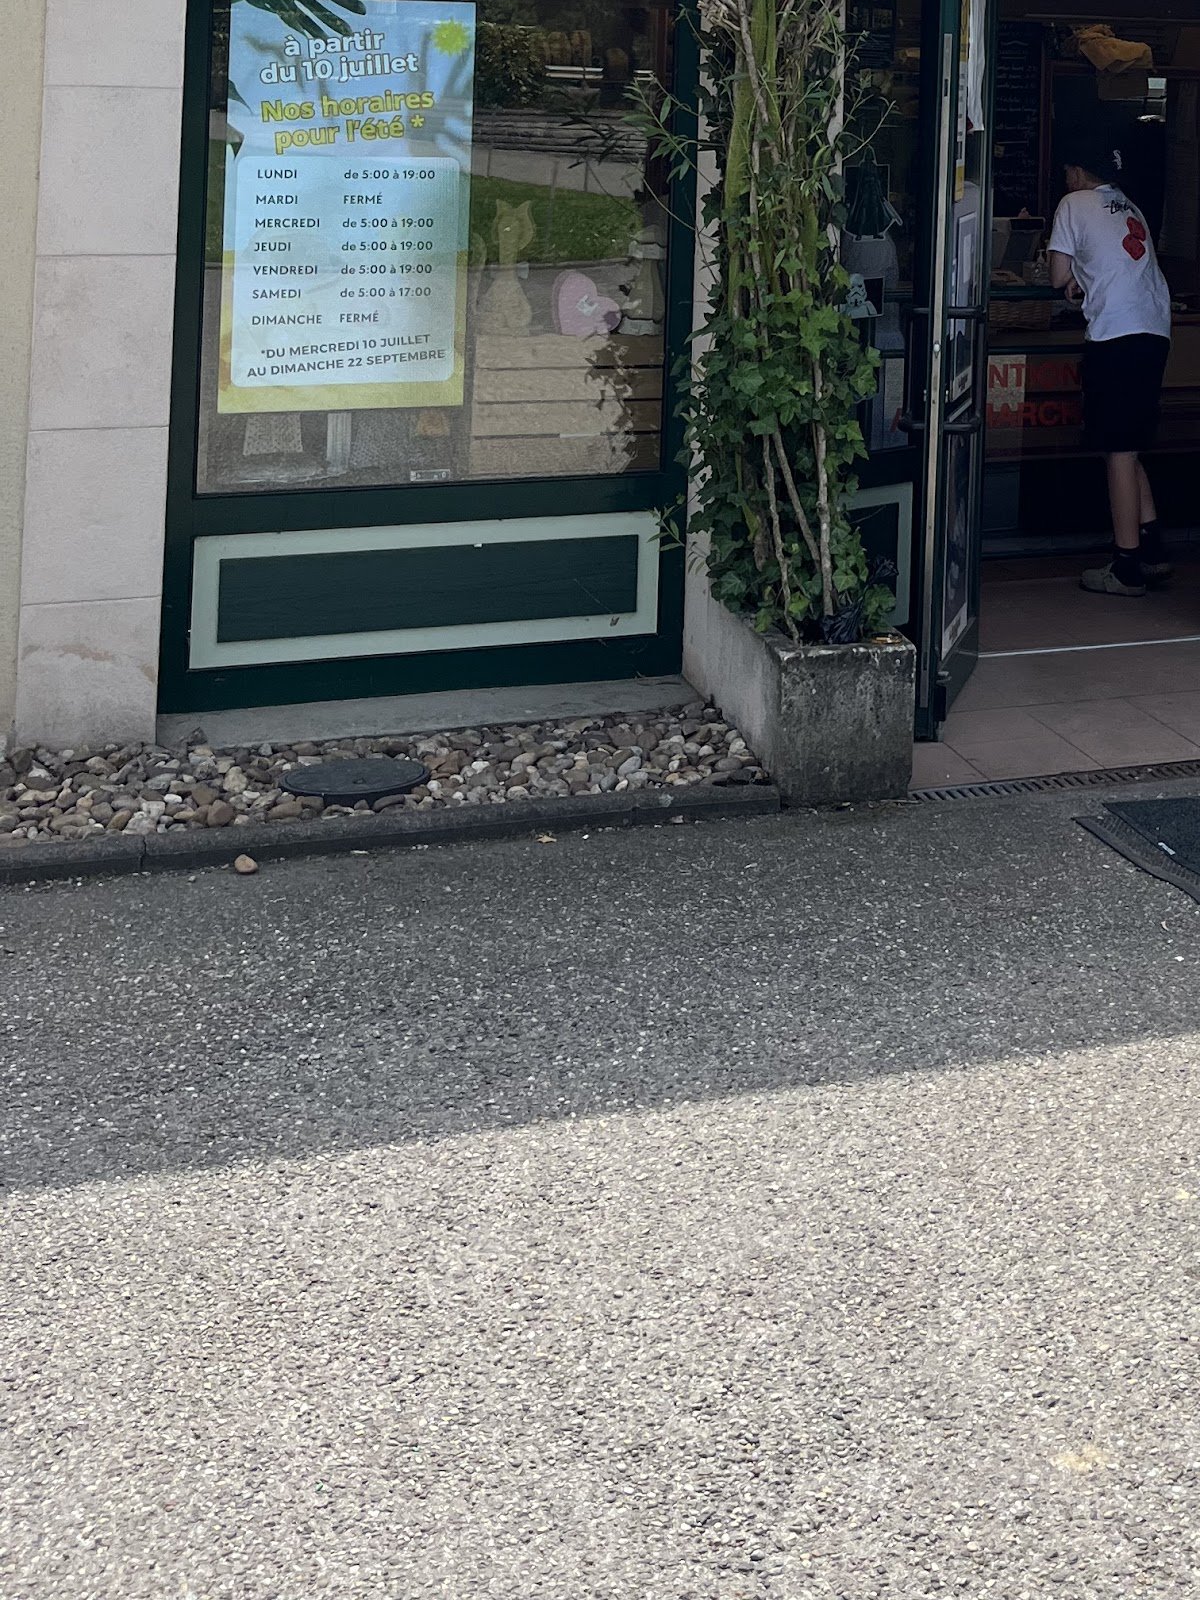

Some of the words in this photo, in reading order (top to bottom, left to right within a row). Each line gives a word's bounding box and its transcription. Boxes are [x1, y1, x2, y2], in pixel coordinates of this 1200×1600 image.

[284, 34, 301, 57] à
[307, 27, 386, 60] partir
[259, 61, 298, 85] du
[301, 58, 334, 81] 10
[338, 52, 420, 83] juillet
[260, 99, 316, 123] Nos
[321, 89, 435, 118] horaires
[274, 124, 340, 155] pour
[345, 114, 405, 143] l'été
[256, 168, 298, 179] LUNDI
[343, 169, 359, 179] de
[361, 169, 390, 179] 5:00
[392, 169, 400, 180] à
[402, 169, 436, 180] 19:00
[255, 194, 299, 205] MARDI
[342, 192, 383, 205] FERMÉ
[254, 217, 321, 229] MERCREDI
[342, 218, 357, 228] de
[360, 218, 388, 228] 5:00
[391, 218, 398, 228] à
[401, 218, 434, 228] 19:00
[253, 241, 292, 252] JEUDI
[341, 241, 356, 251] de
[359, 241, 387, 251] 5:00
[390, 241, 398, 251] à
[400, 240, 433, 251] 19:00
[253, 265, 318, 276] VENDREDI
[340, 264, 355, 275] de
[358, 264, 387, 274] 5:00
[389, 264, 397, 274] à
[399, 264, 433, 274] 19:00
[252, 289, 301, 299] SAMEDI
[339, 288, 355, 298] de
[358, 287, 386, 298] 5:00
[388, 287, 396, 297] à
[398, 287, 432, 297] 17:00
[251, 314, 322, 326] DIMANCHE
[339, 310, 380, 323] FERMÉ
[289, 341, 359, 357] MERCREDI
[362, 339, 377, 349] 10
[379, 333, 431, 347] JUILLET
[247, 366, 267, 378] AU
[270, 359, 344, 376] DIMANCHE
[347, 356, 363, 368] 22
[365, 349, 446, 366] SEPTEMBRE
